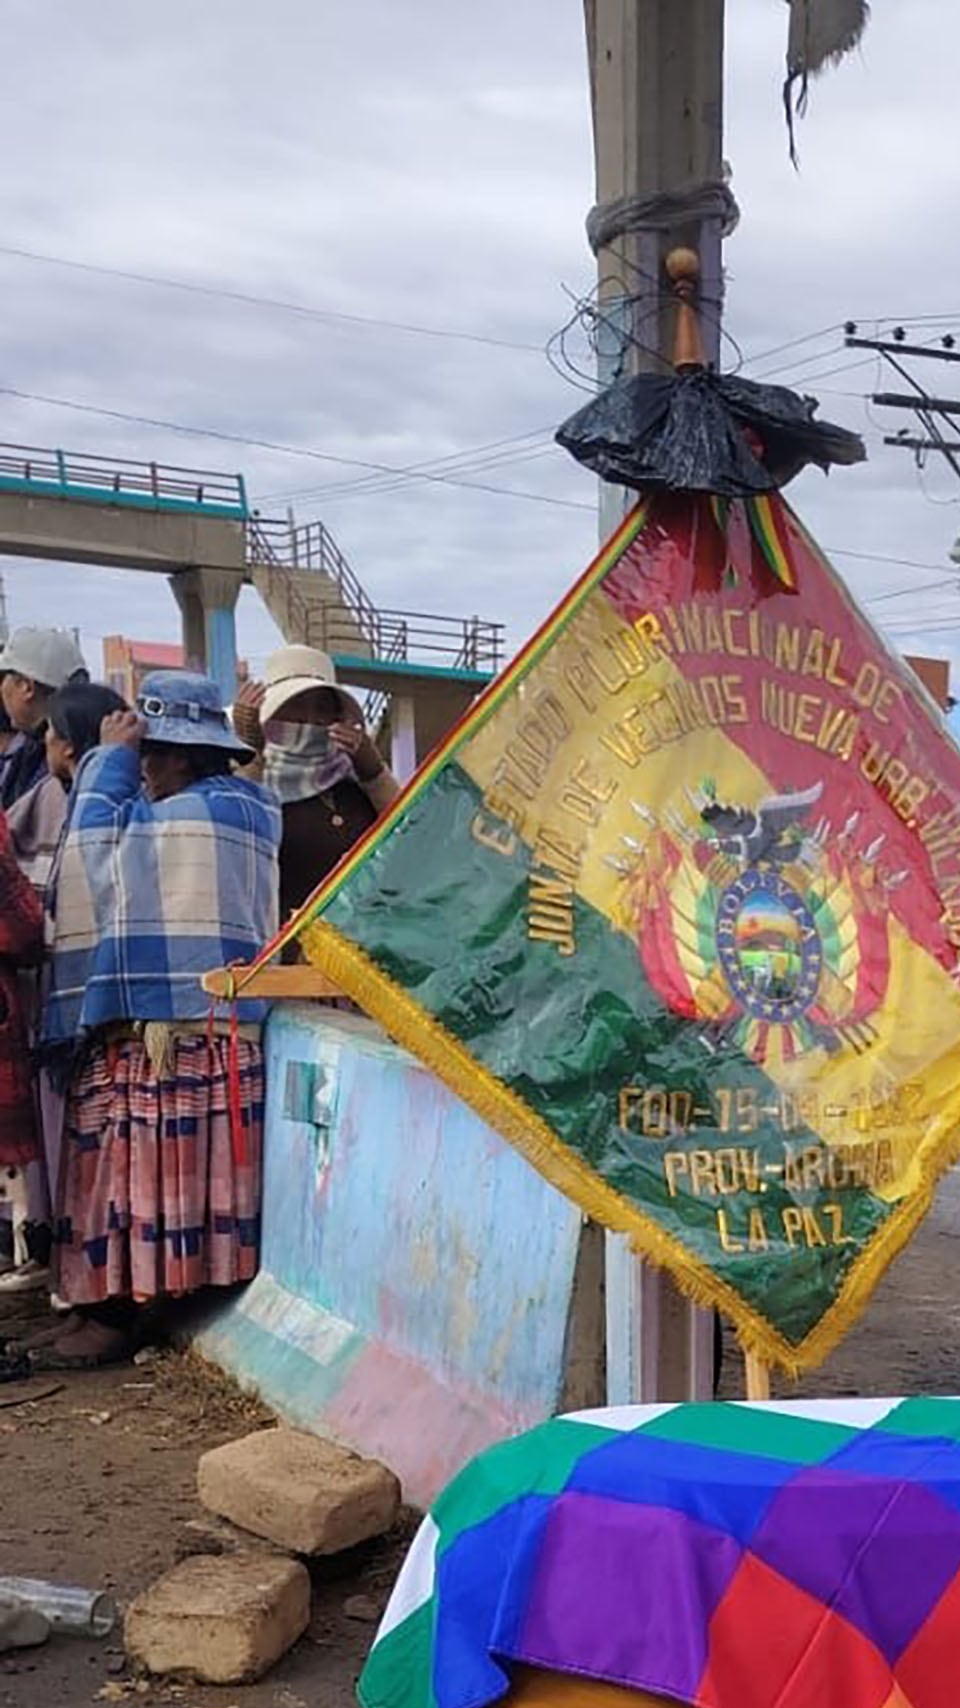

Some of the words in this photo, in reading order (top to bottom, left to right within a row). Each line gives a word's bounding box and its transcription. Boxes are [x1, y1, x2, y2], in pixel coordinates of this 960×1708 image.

[472, 690, 573, 856] ESTADO
[563, 600, 848, 713] PLURINACIONAL
[854, 661, 902, 723] DE
[527, 826, 582, 957] JUNTA
[560, 755, 619, 827] DE
[599, 674, 750, 769] VECINOS
[761, 678, 862, 761] NUEVA
[860, 740, 930, 828] URB.
[718, 873, 816, 943] BOLIVIA
[716, 1206, 770, 1252] LA
[782, 1203, 854, 1248] PAZ
